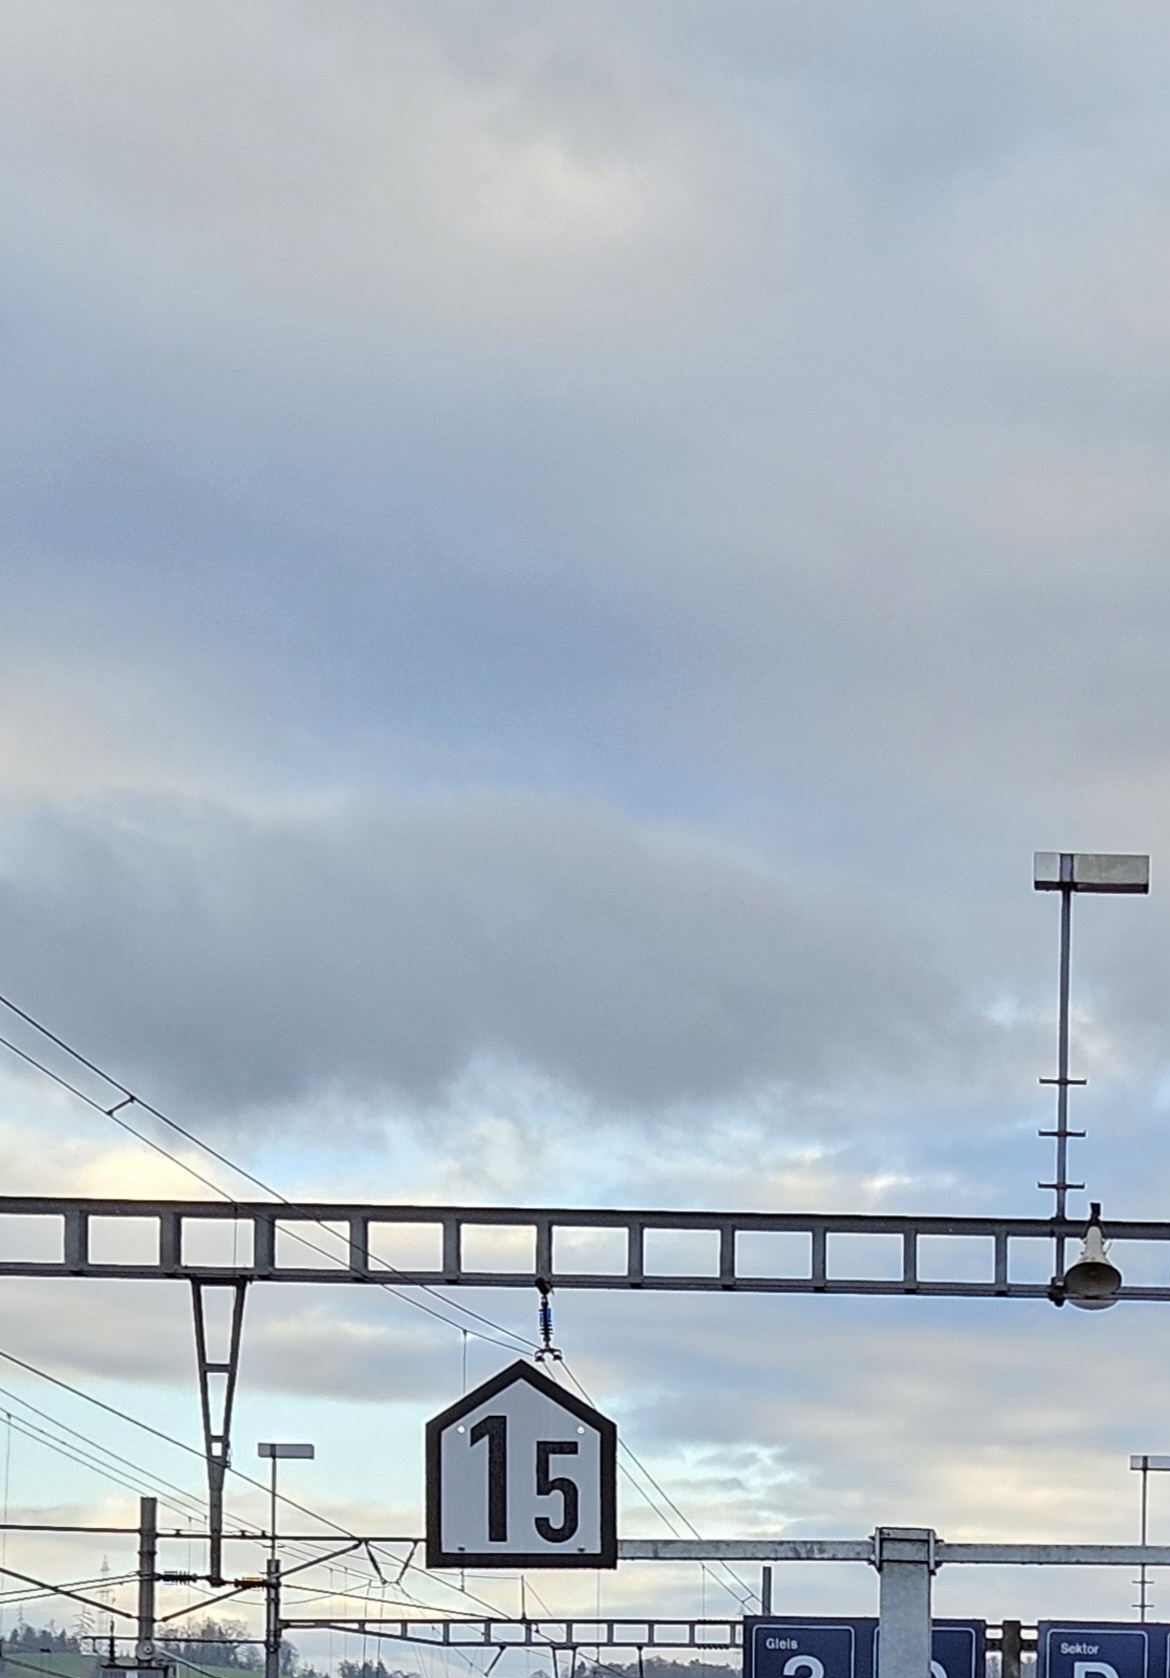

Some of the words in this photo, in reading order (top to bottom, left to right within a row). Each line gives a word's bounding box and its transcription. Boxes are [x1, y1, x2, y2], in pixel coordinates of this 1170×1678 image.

[470, 1415, 579, 1543] 15
[765, 1637, 798, 1650] Gleis
[1060, 1642, 1100, 1655] Sektor
